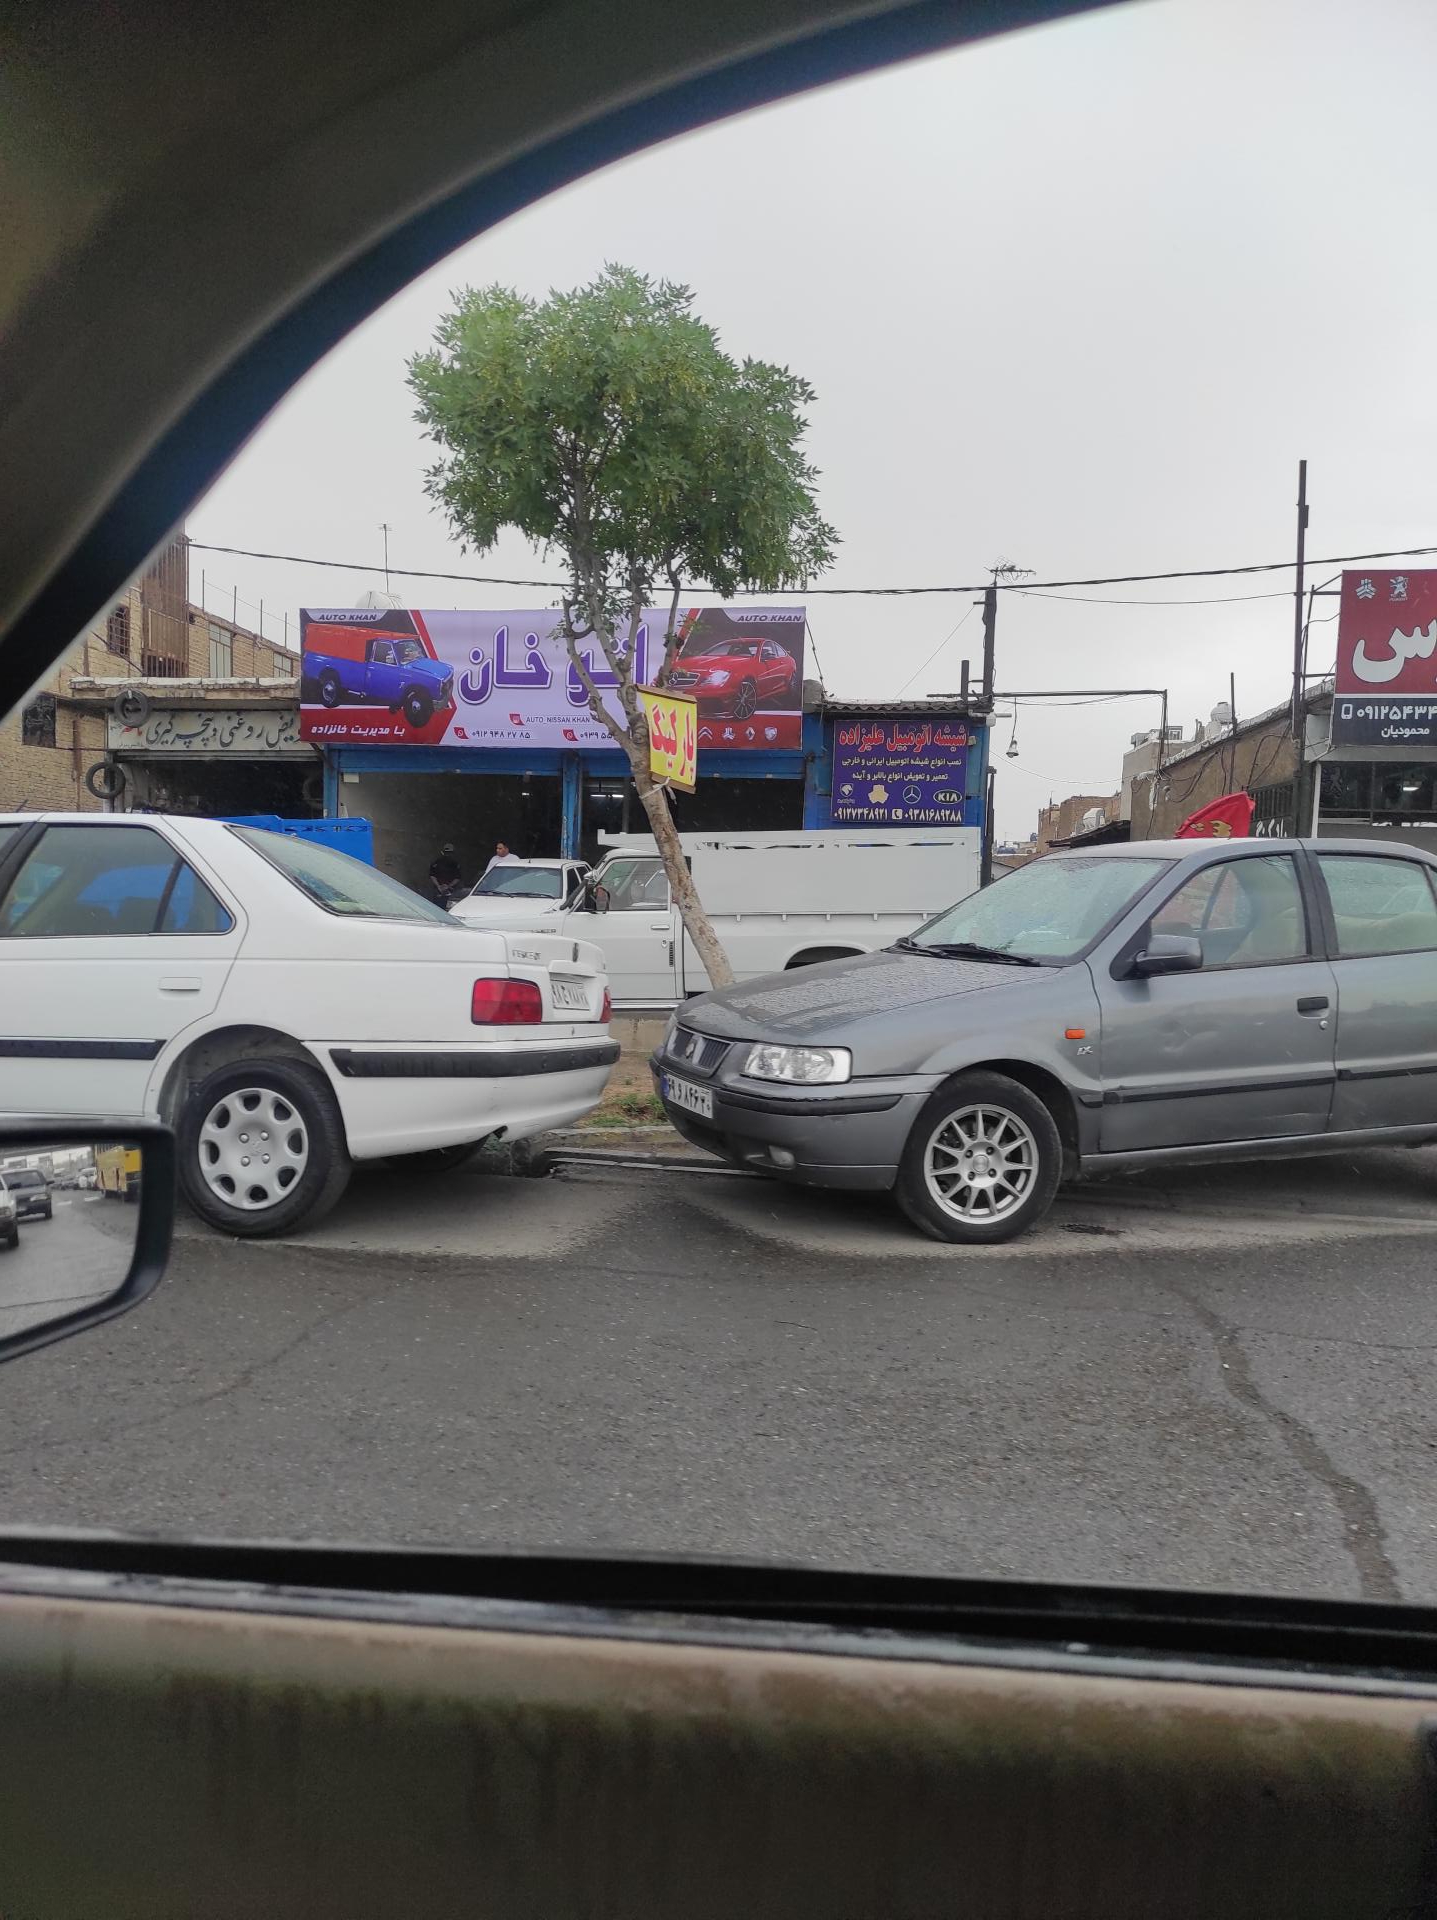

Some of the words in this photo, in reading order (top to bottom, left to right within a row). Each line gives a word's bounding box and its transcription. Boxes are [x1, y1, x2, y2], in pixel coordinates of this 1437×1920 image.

[1353, 618, 1437, 683] س
[458, 624, 553, 705] خان
[311, 724, 348, 736] خانزاده
[350, 724, 391, 737] مدیریت
[394, 725, 406, 737] با
[472, 730, 488, 738] ۰۹۱۲
[519, 731, 531, 739] ۸۵
[580, 731, 599, 739] ۰۹۳۹
[1381, 724, 1430, 738] محمودیان
[838, 723, 885, 753] علیزاده
[886, 723, 932, 753] اتومبیل
[933, 724, 967, 752] شیشه
[841, 756, 860, 767] خارجی
[866, 757, 885, 766] ایرانی
[910, 757, 930, 767] شیشه
[930, 757, 946, 769] انواع
[946, 758, 962, 768] نصب
[887, 772, 903, 783] انواع
[903, 772, 925, 782] تعویض
[931, 773, 949, 782] تعمیر
[937, 793, 959, 802] KIA
